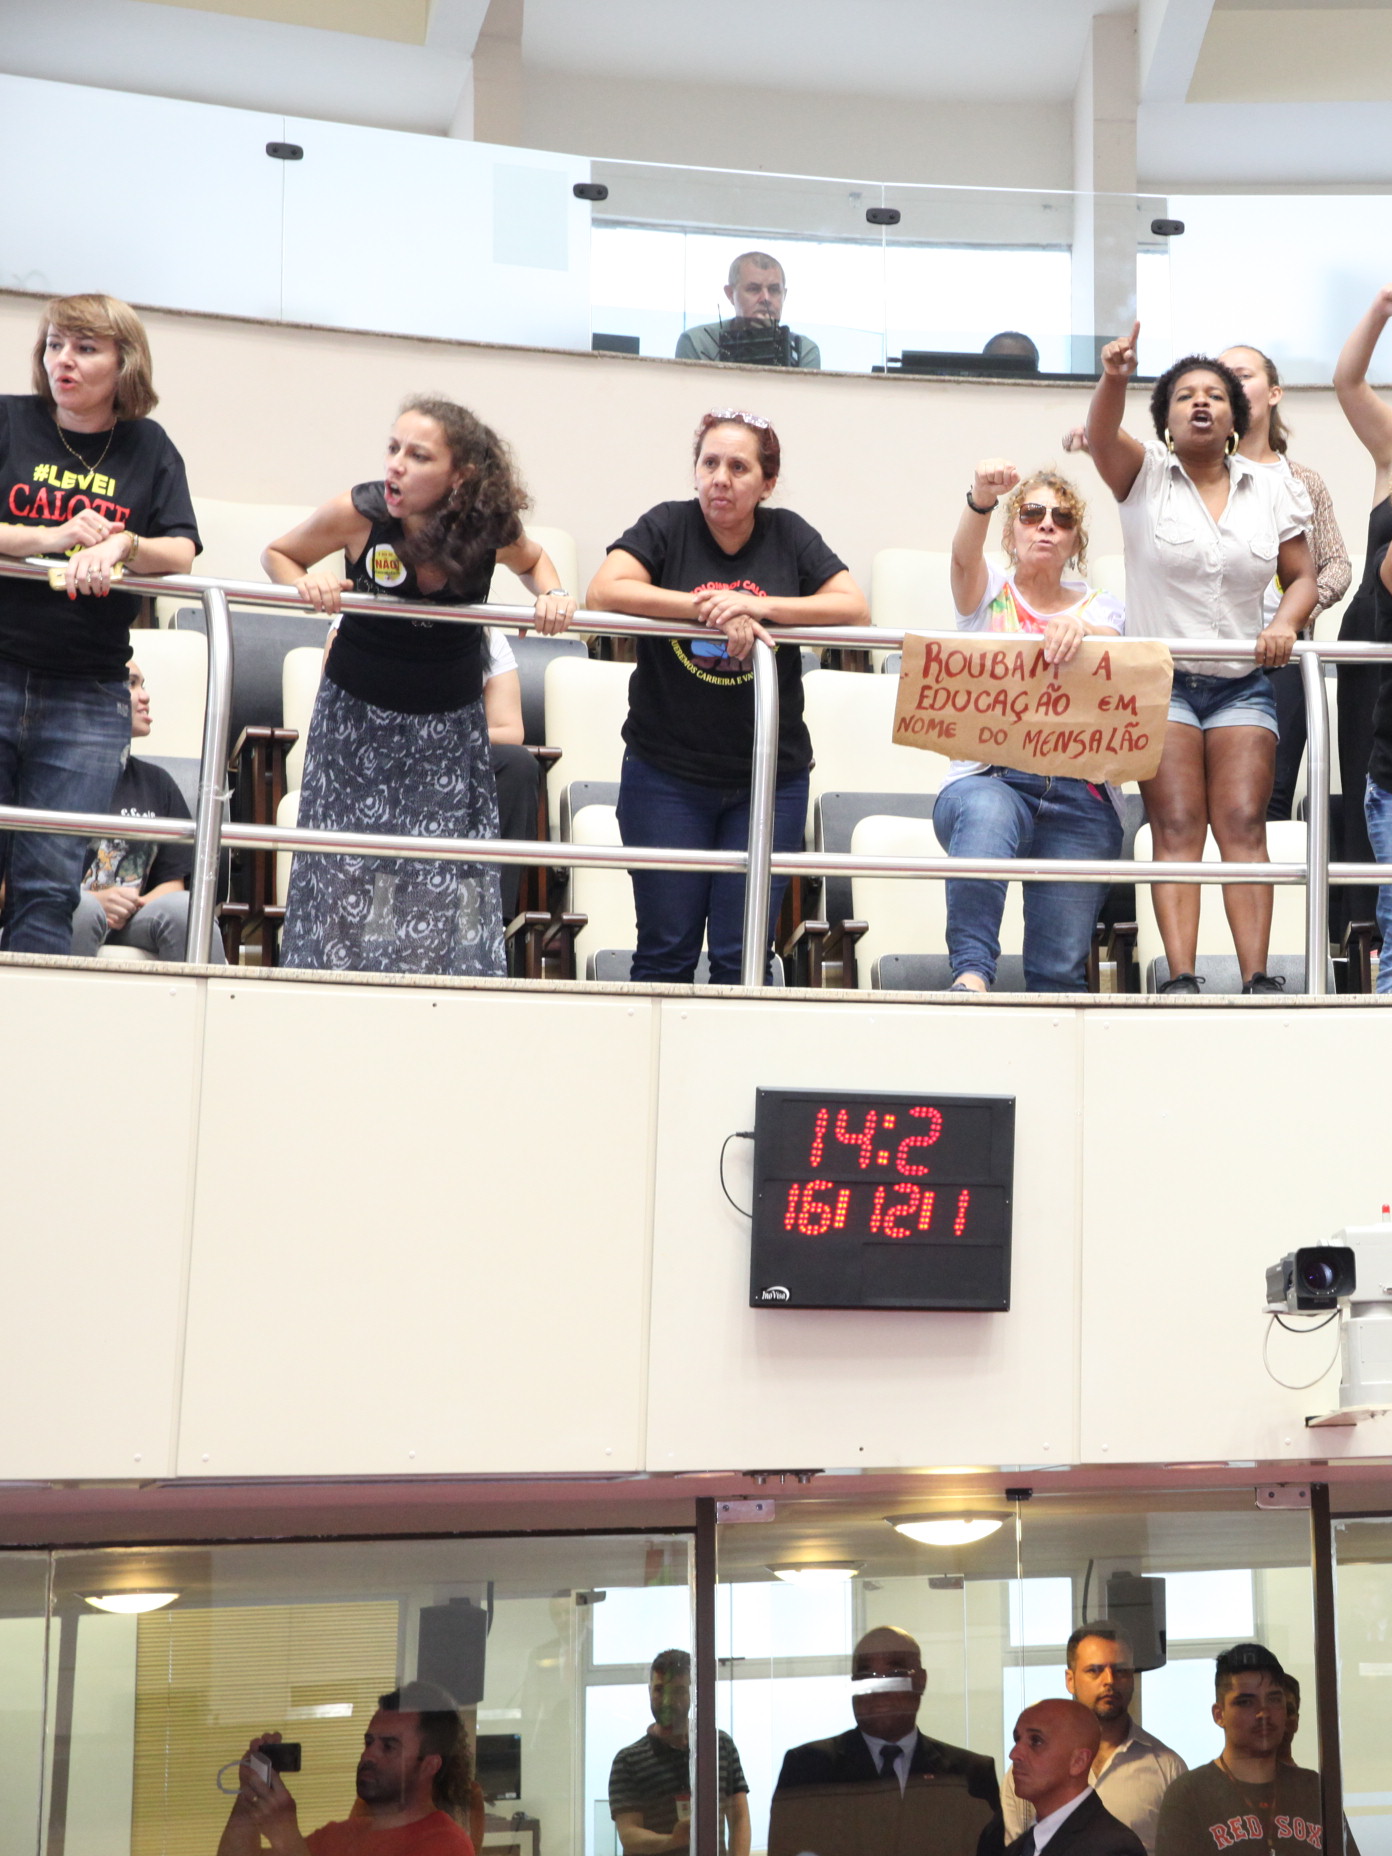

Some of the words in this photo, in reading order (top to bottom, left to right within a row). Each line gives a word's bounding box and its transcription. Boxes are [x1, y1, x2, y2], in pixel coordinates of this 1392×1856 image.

[33, 463, 116, 497] #LEVEI
[669, 639, 698, 674] UEREMOS
[696, 669, 736, 686] CARREIRA
[737, 676, 743, 684] E
[922, 641, 1060, 683] ROUBAM
[1092, 650, 1112, 681] A
[915, 683, 1071, 725] EDUCAÇÃO
[1097, 695, 1138, 717] EM
[896, 714, 957, 740] NOME
[978, 726, 1008, 746] DO
[1022, 721, 1149, 760] MENSALÃO
[809, 1106, 943, 1176] 14:2
[1208, 1814, 1264, 1851] RED
[1274, 1815, 1323, 1850] SOX
